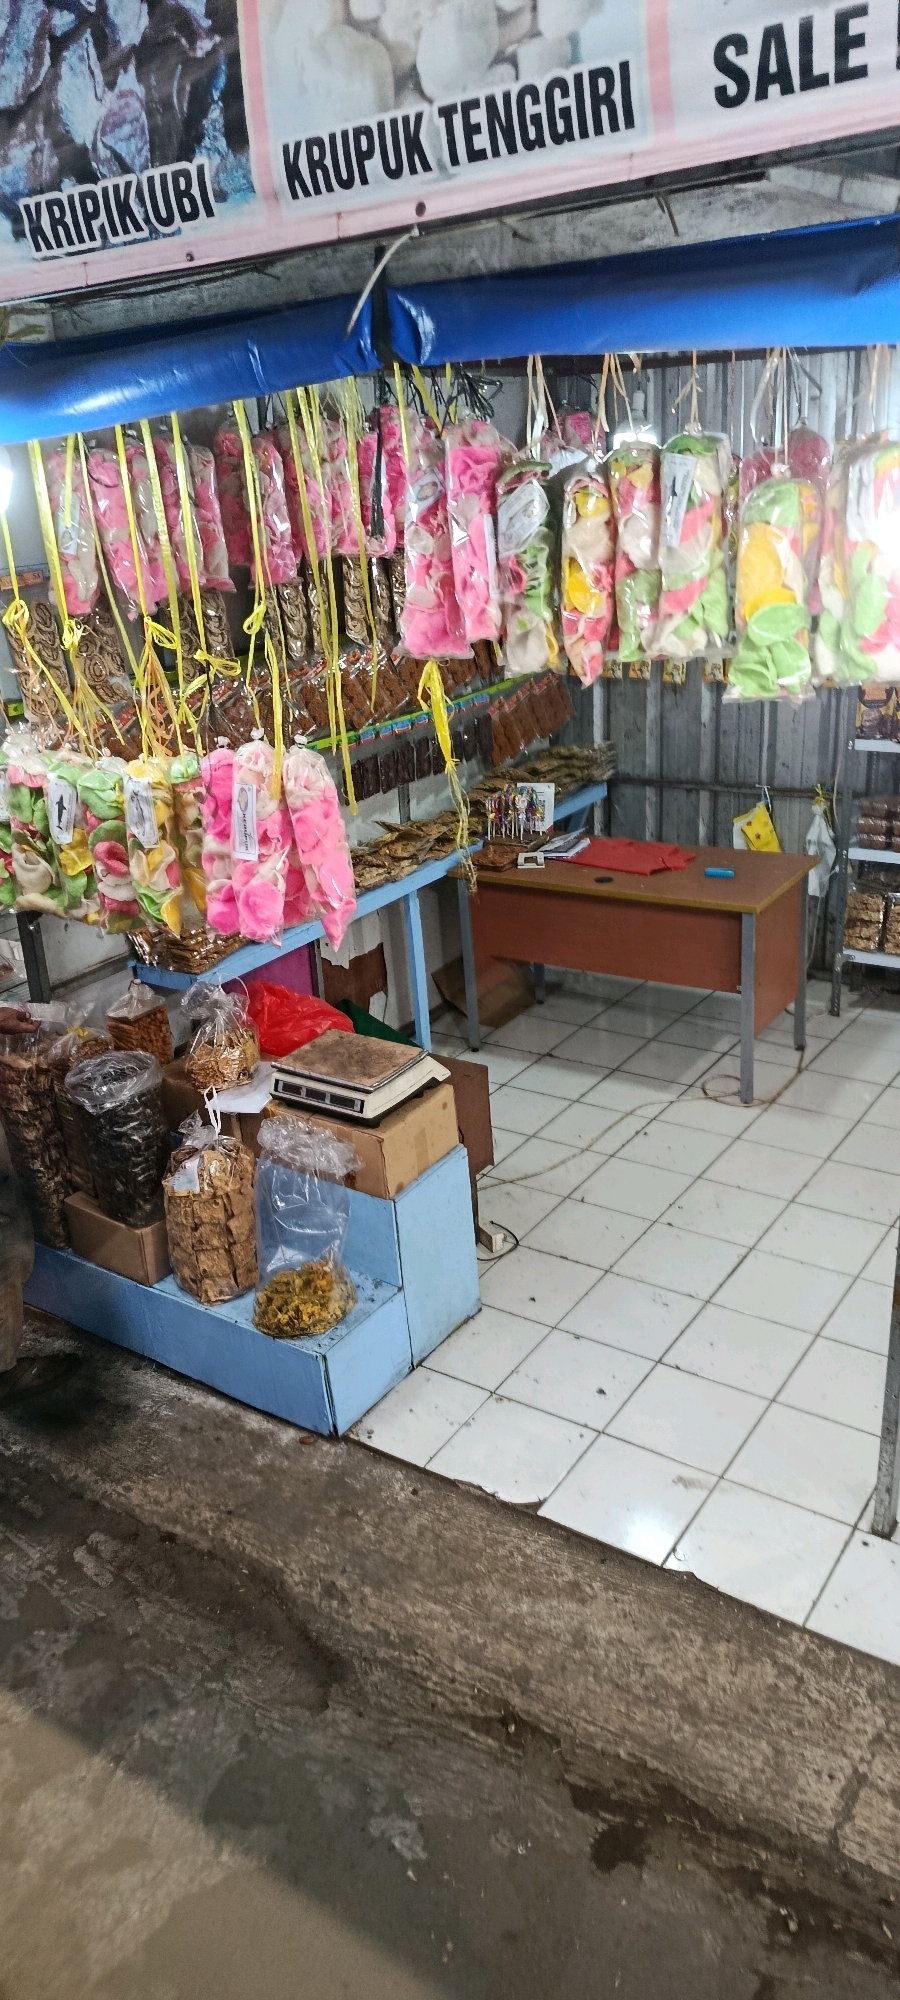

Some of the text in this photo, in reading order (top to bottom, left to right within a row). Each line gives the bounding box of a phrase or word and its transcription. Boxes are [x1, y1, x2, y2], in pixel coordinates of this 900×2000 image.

[713, 2, 869, 108] SALE
[282, 60, 635, 200] KRUPUK TENGGIRI
[23, 164, 215, 252] KRIPIK UBI
